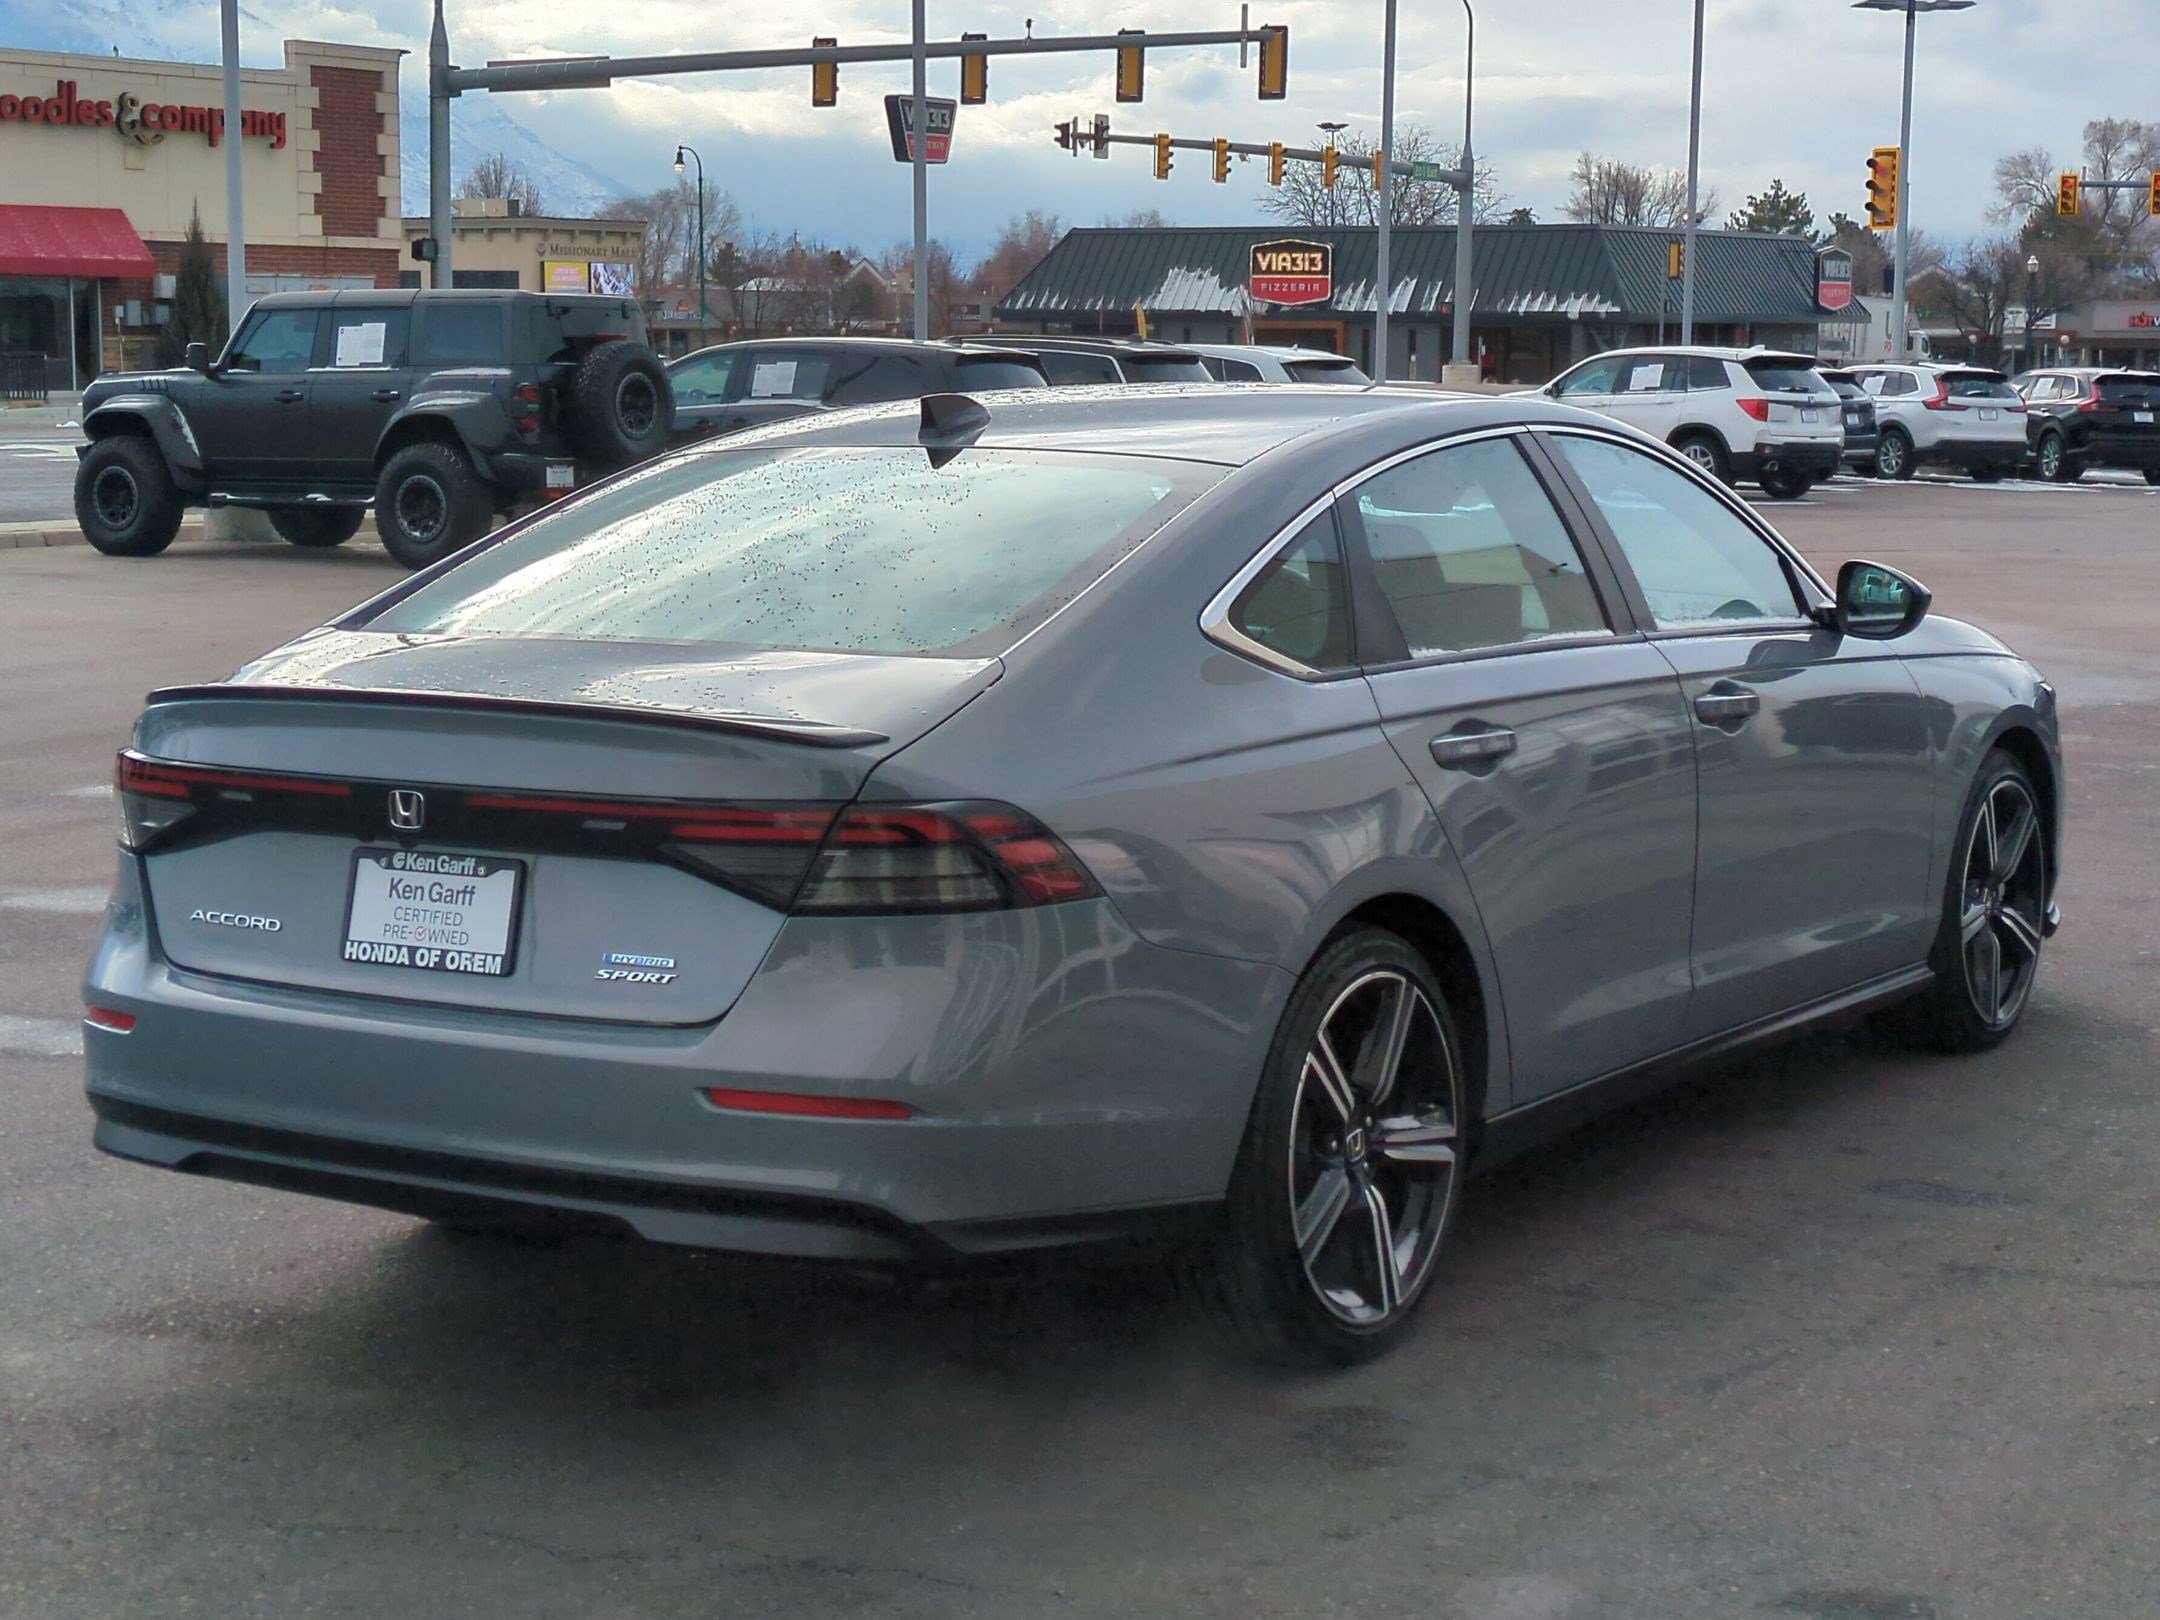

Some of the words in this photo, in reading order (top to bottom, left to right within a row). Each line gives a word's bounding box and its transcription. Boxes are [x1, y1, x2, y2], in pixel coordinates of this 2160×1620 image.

[1256, 252, 1322, 271] VIA313
[1260, 283, 1320, 292] PIZZERIA
[405, 852, 435, 872] Ken
[437, 855, 476, 875] Garff
[388, 877, 425, 902] Ken
[428, 882, 476, 906] Garff
[190, 909, 281, 931] ACCORD
[393, 906, 463, 927] CERTIFIED
[344, 941, 409, 965] HONDA
[415, 948, 441, 968] OF
[445, 952, 502, 975] OREM
[612, 954, 672, 967] HYBRID
[594, 969, 677, 984] SPORT
